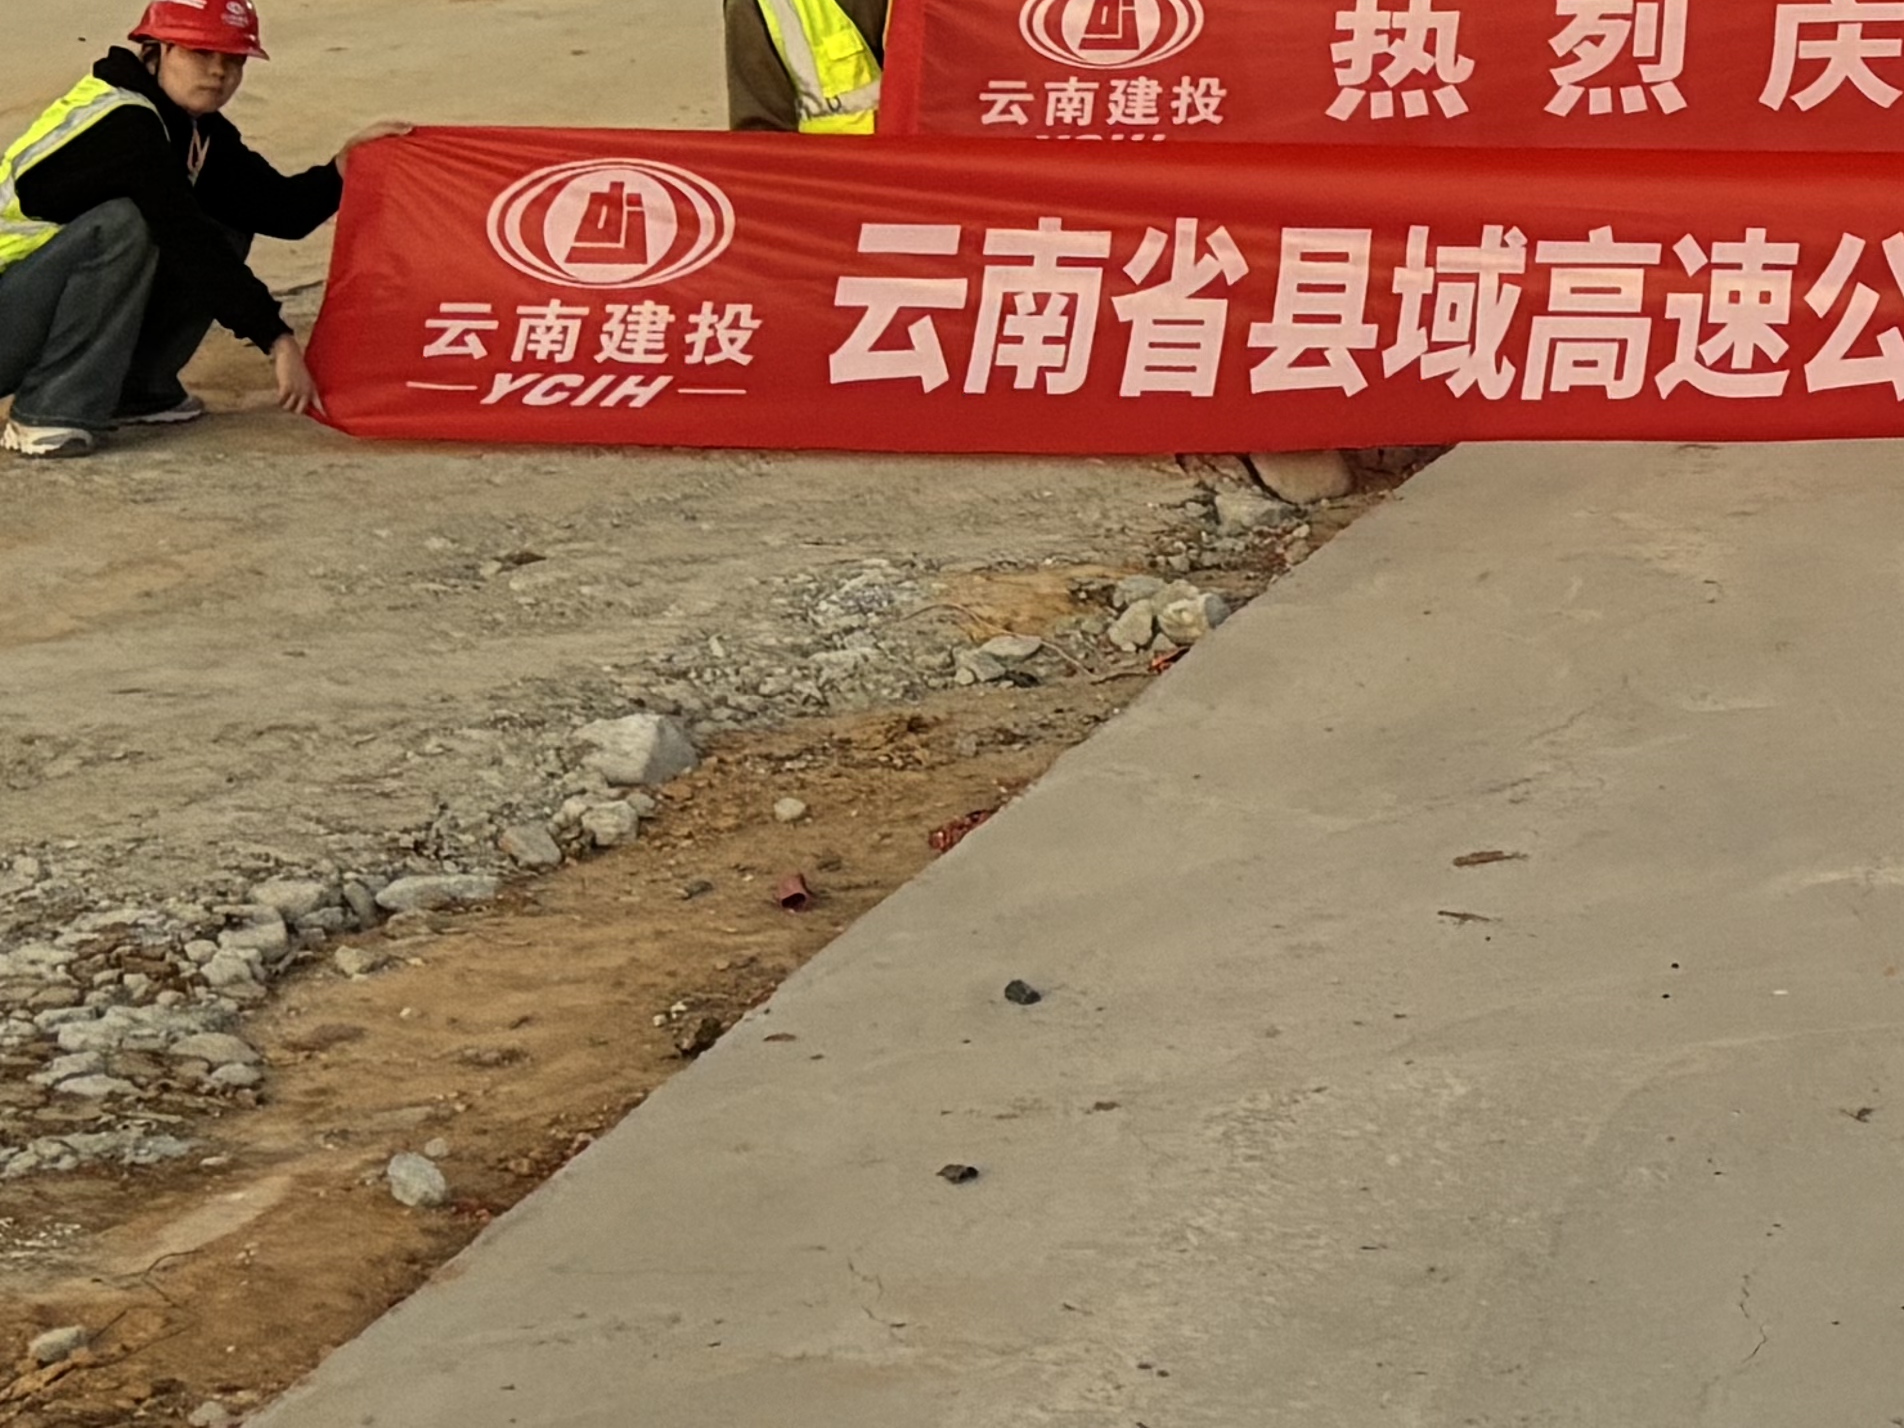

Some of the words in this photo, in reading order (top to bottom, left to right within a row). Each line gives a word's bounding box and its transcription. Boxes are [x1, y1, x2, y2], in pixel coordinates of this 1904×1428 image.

[979, 75, 1227, 127] 云南建投
[422, 298, 763, 366] 云南建投
[480, 372, 674, 408] YCIH
